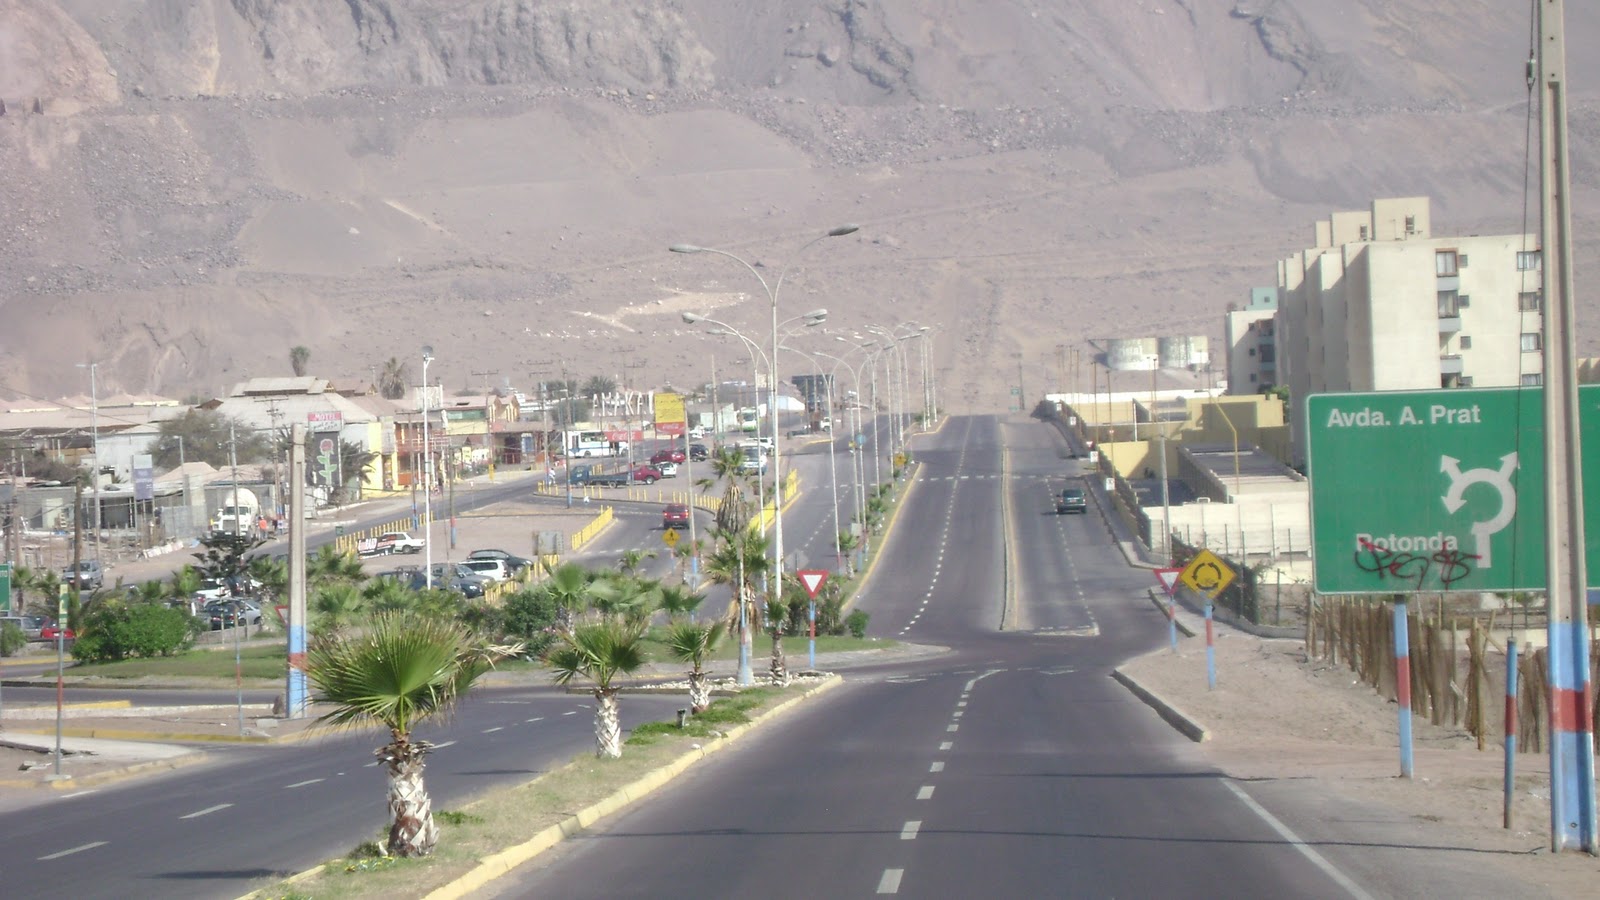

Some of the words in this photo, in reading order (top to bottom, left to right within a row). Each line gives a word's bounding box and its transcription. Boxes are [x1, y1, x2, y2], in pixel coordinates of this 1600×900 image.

[1327, 407, 1391, 428] Avda.
[1399, 405, 1424, 426] A.
[1431, 404, 1481, 425] Prat
[1356, 532, 1458, 552] Rotonda
